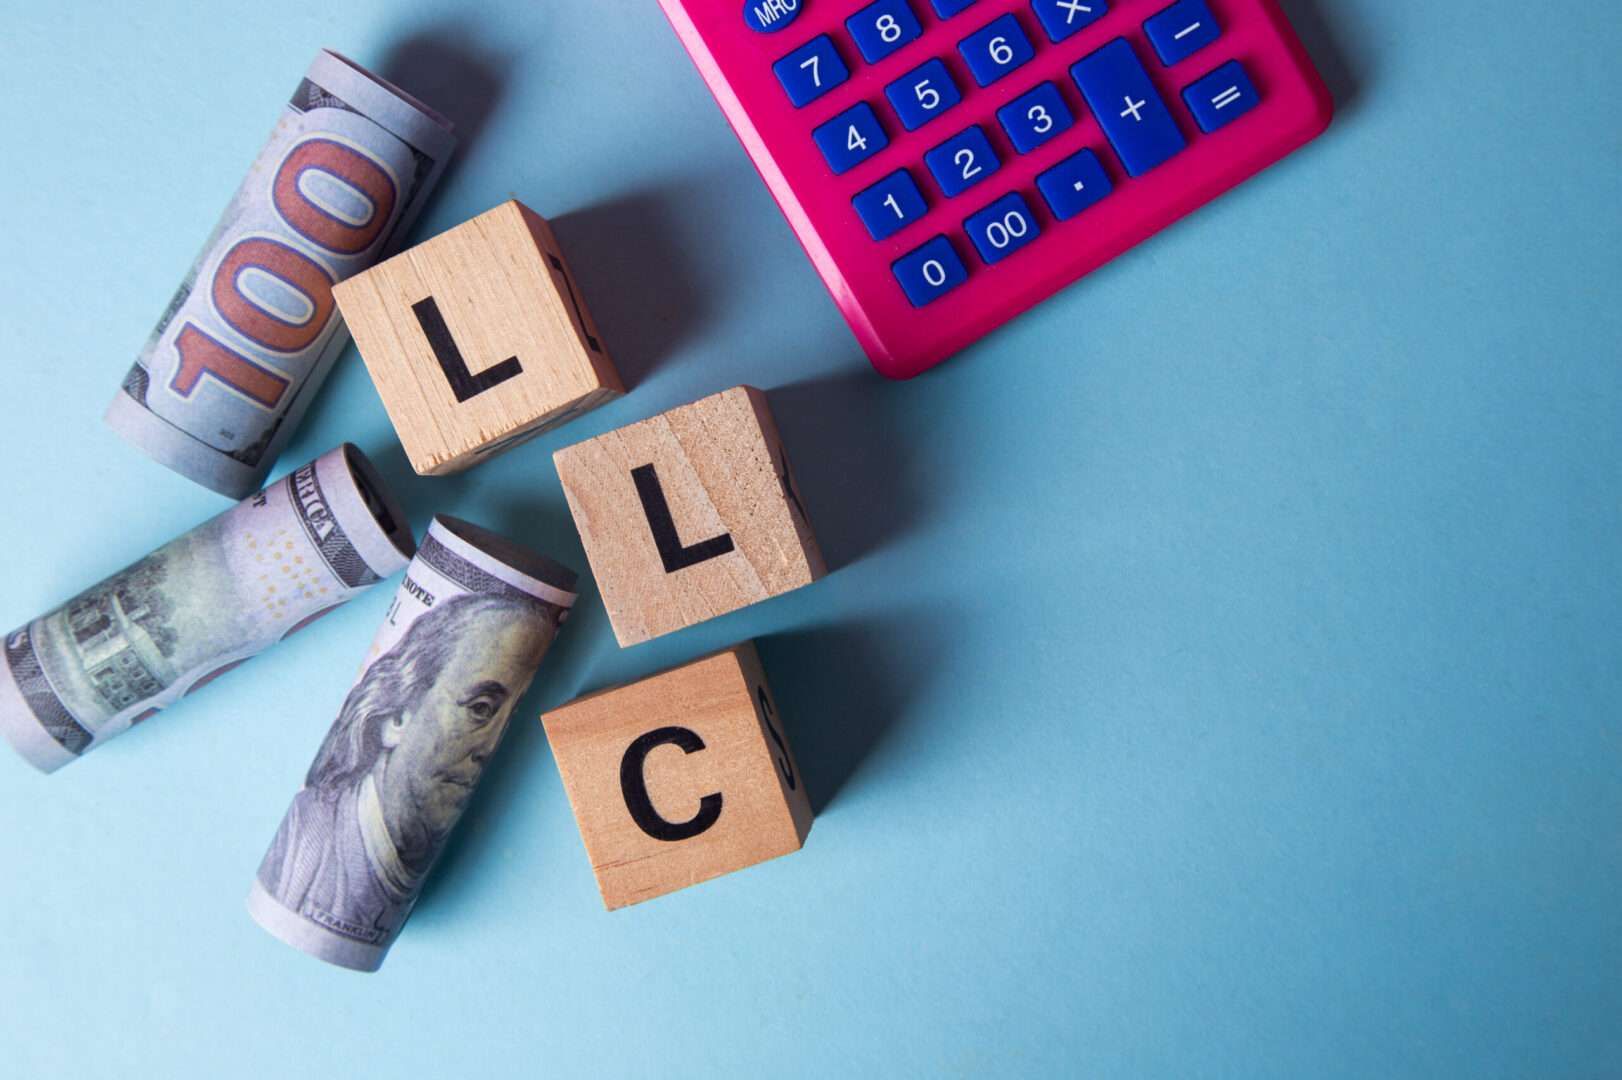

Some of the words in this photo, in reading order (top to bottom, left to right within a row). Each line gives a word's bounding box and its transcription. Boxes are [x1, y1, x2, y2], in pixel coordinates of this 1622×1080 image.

[875, 14, 902, 43] 8
[989, 36, 1013, 65] 6
[800, 55, 821, 88] 7
[914, 79, 940, 110] 5
[1028, 105, 1053, 133] 3
[847, 124, 867, 151] 4
[954, 148, 982, 180] 2
[883, 193, 904, 219] 1
[986, 210, 1028, 248] 00
[168, 131, 402, 410] 100
[921, 259, 947, 287] 0
[412, 297, 523, 403] L
[630, 463, 734, 573] L
[620, 726, 723, 842] C
